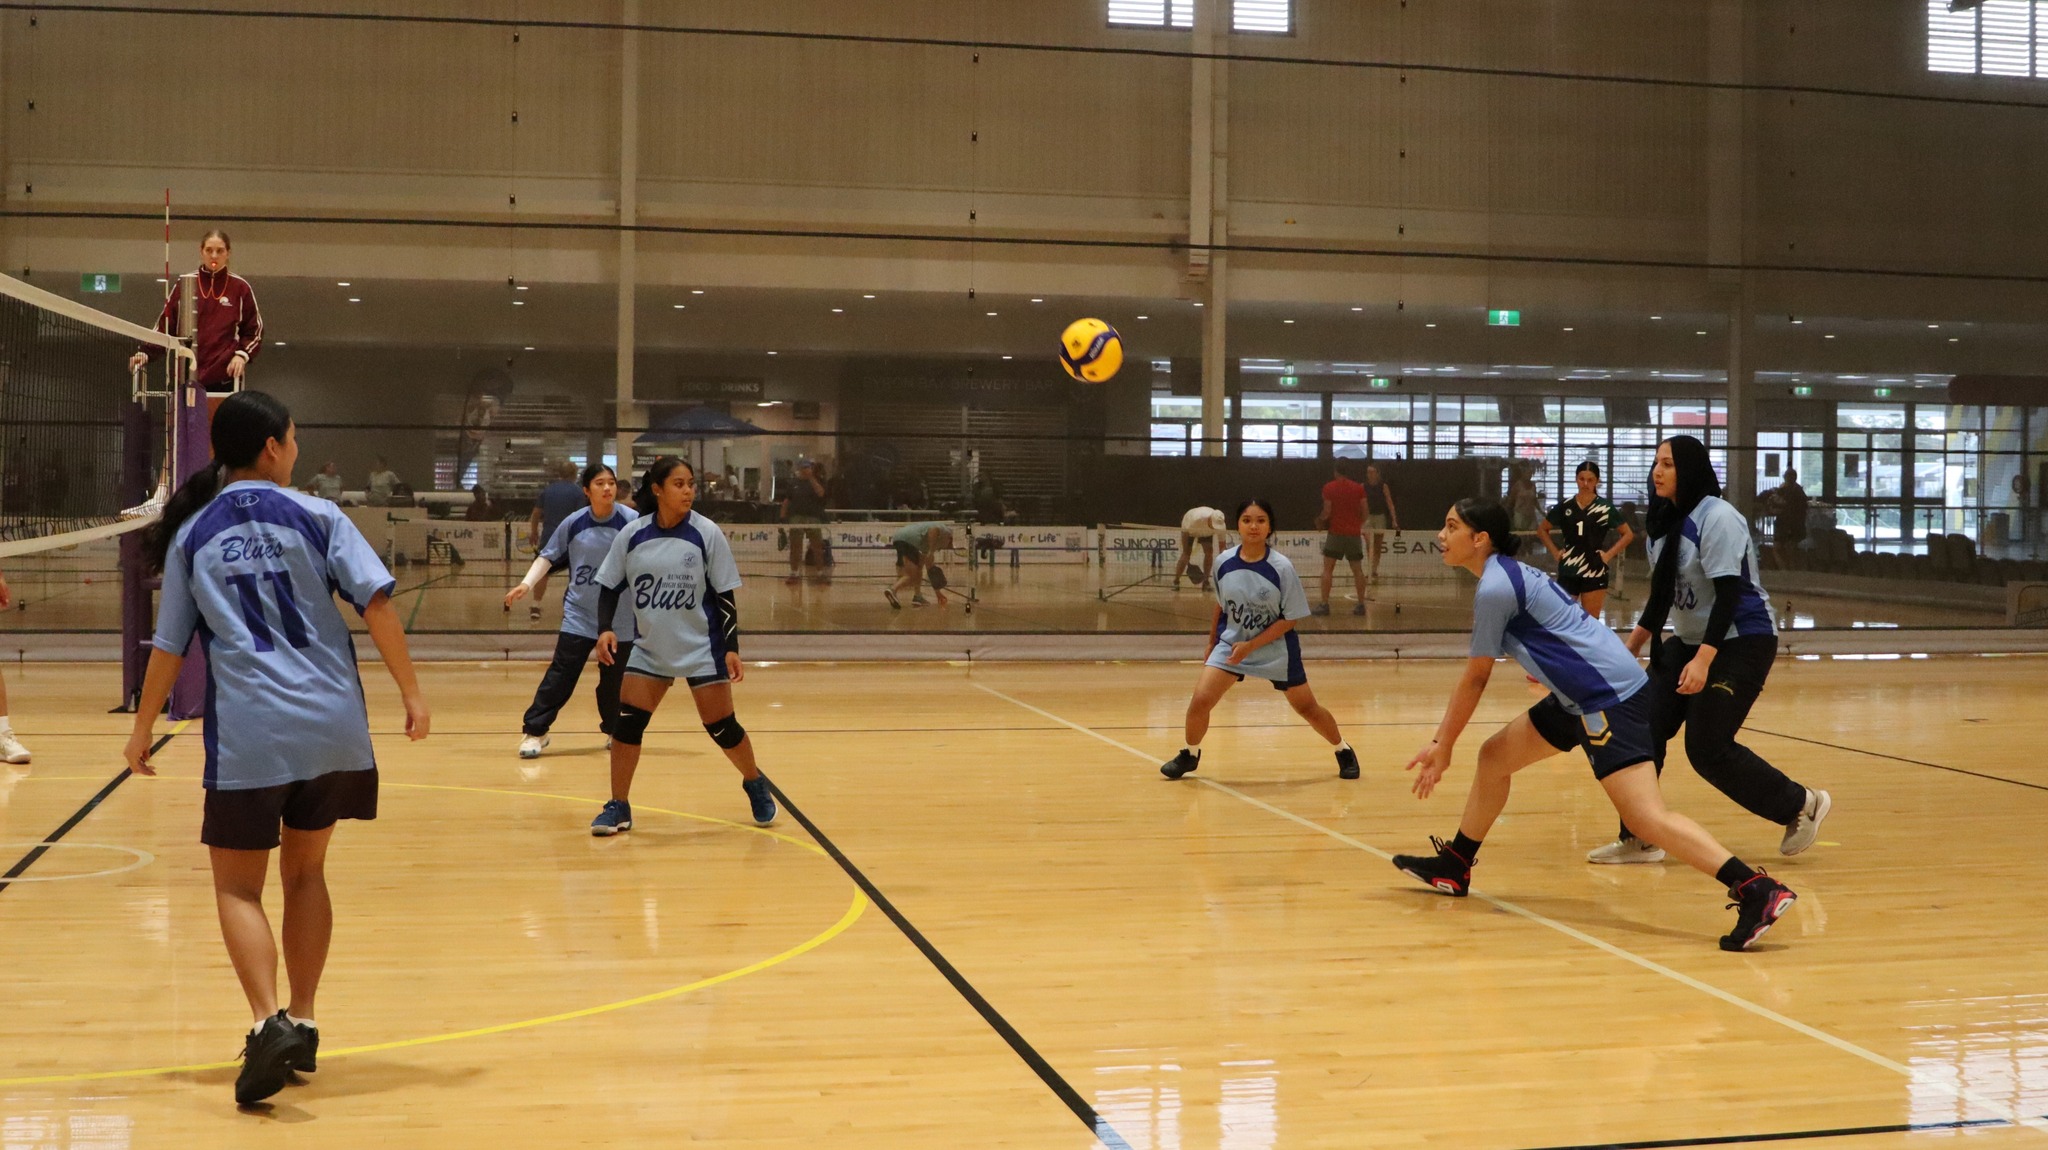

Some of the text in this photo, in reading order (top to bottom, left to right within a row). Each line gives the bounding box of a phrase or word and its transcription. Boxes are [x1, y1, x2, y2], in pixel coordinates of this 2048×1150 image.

[720, 383, 760, 392] DRINKS
[950, 379, 1019, 390] BREWERY
[1576, 521, 1584, 536] 1
[865, 533, 873, 543] it
[1008, 534, 1016, 543] it
[1114, 538, 1176, 549] SUNCORP
[220, 536, 286, 562] Blues
[1114, 551, 1144, 561] TEAM
[667, 573, 694, 581] RUNCORN
[677, 582, 697, 590] SCHOOL
[634, 573, 697, 610] Blues
[225, 570, 311, 652] 11
